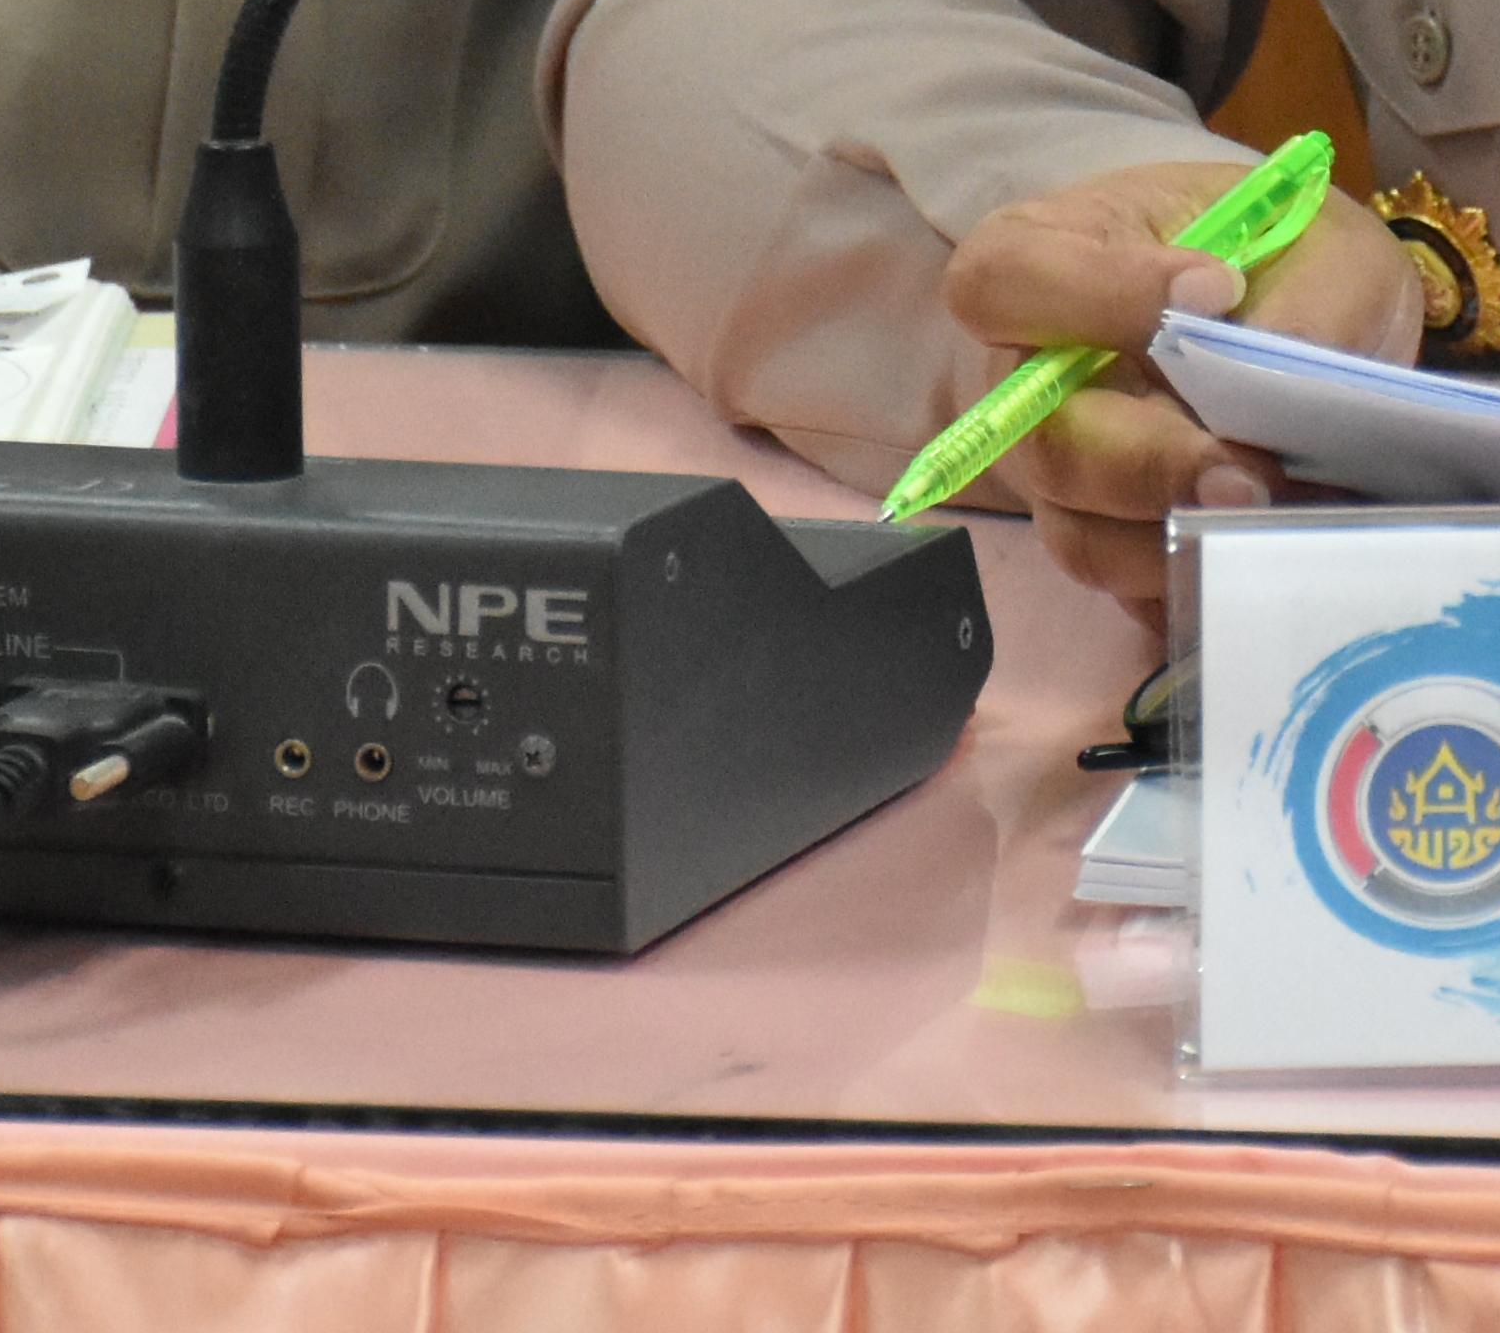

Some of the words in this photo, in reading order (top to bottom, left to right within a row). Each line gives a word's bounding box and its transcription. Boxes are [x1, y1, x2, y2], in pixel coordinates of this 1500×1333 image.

[386, 579, 588, 644] NPE
[386, 638, 588, 664] RESEARCH
[417, 756, 450, 772] MIN
[475, 760, 512, 776] MAX
[269, 794, 315, 817] REC
[333, 800, 412, 824] PHONE
[417, 786, 512, 810] VOLUME
